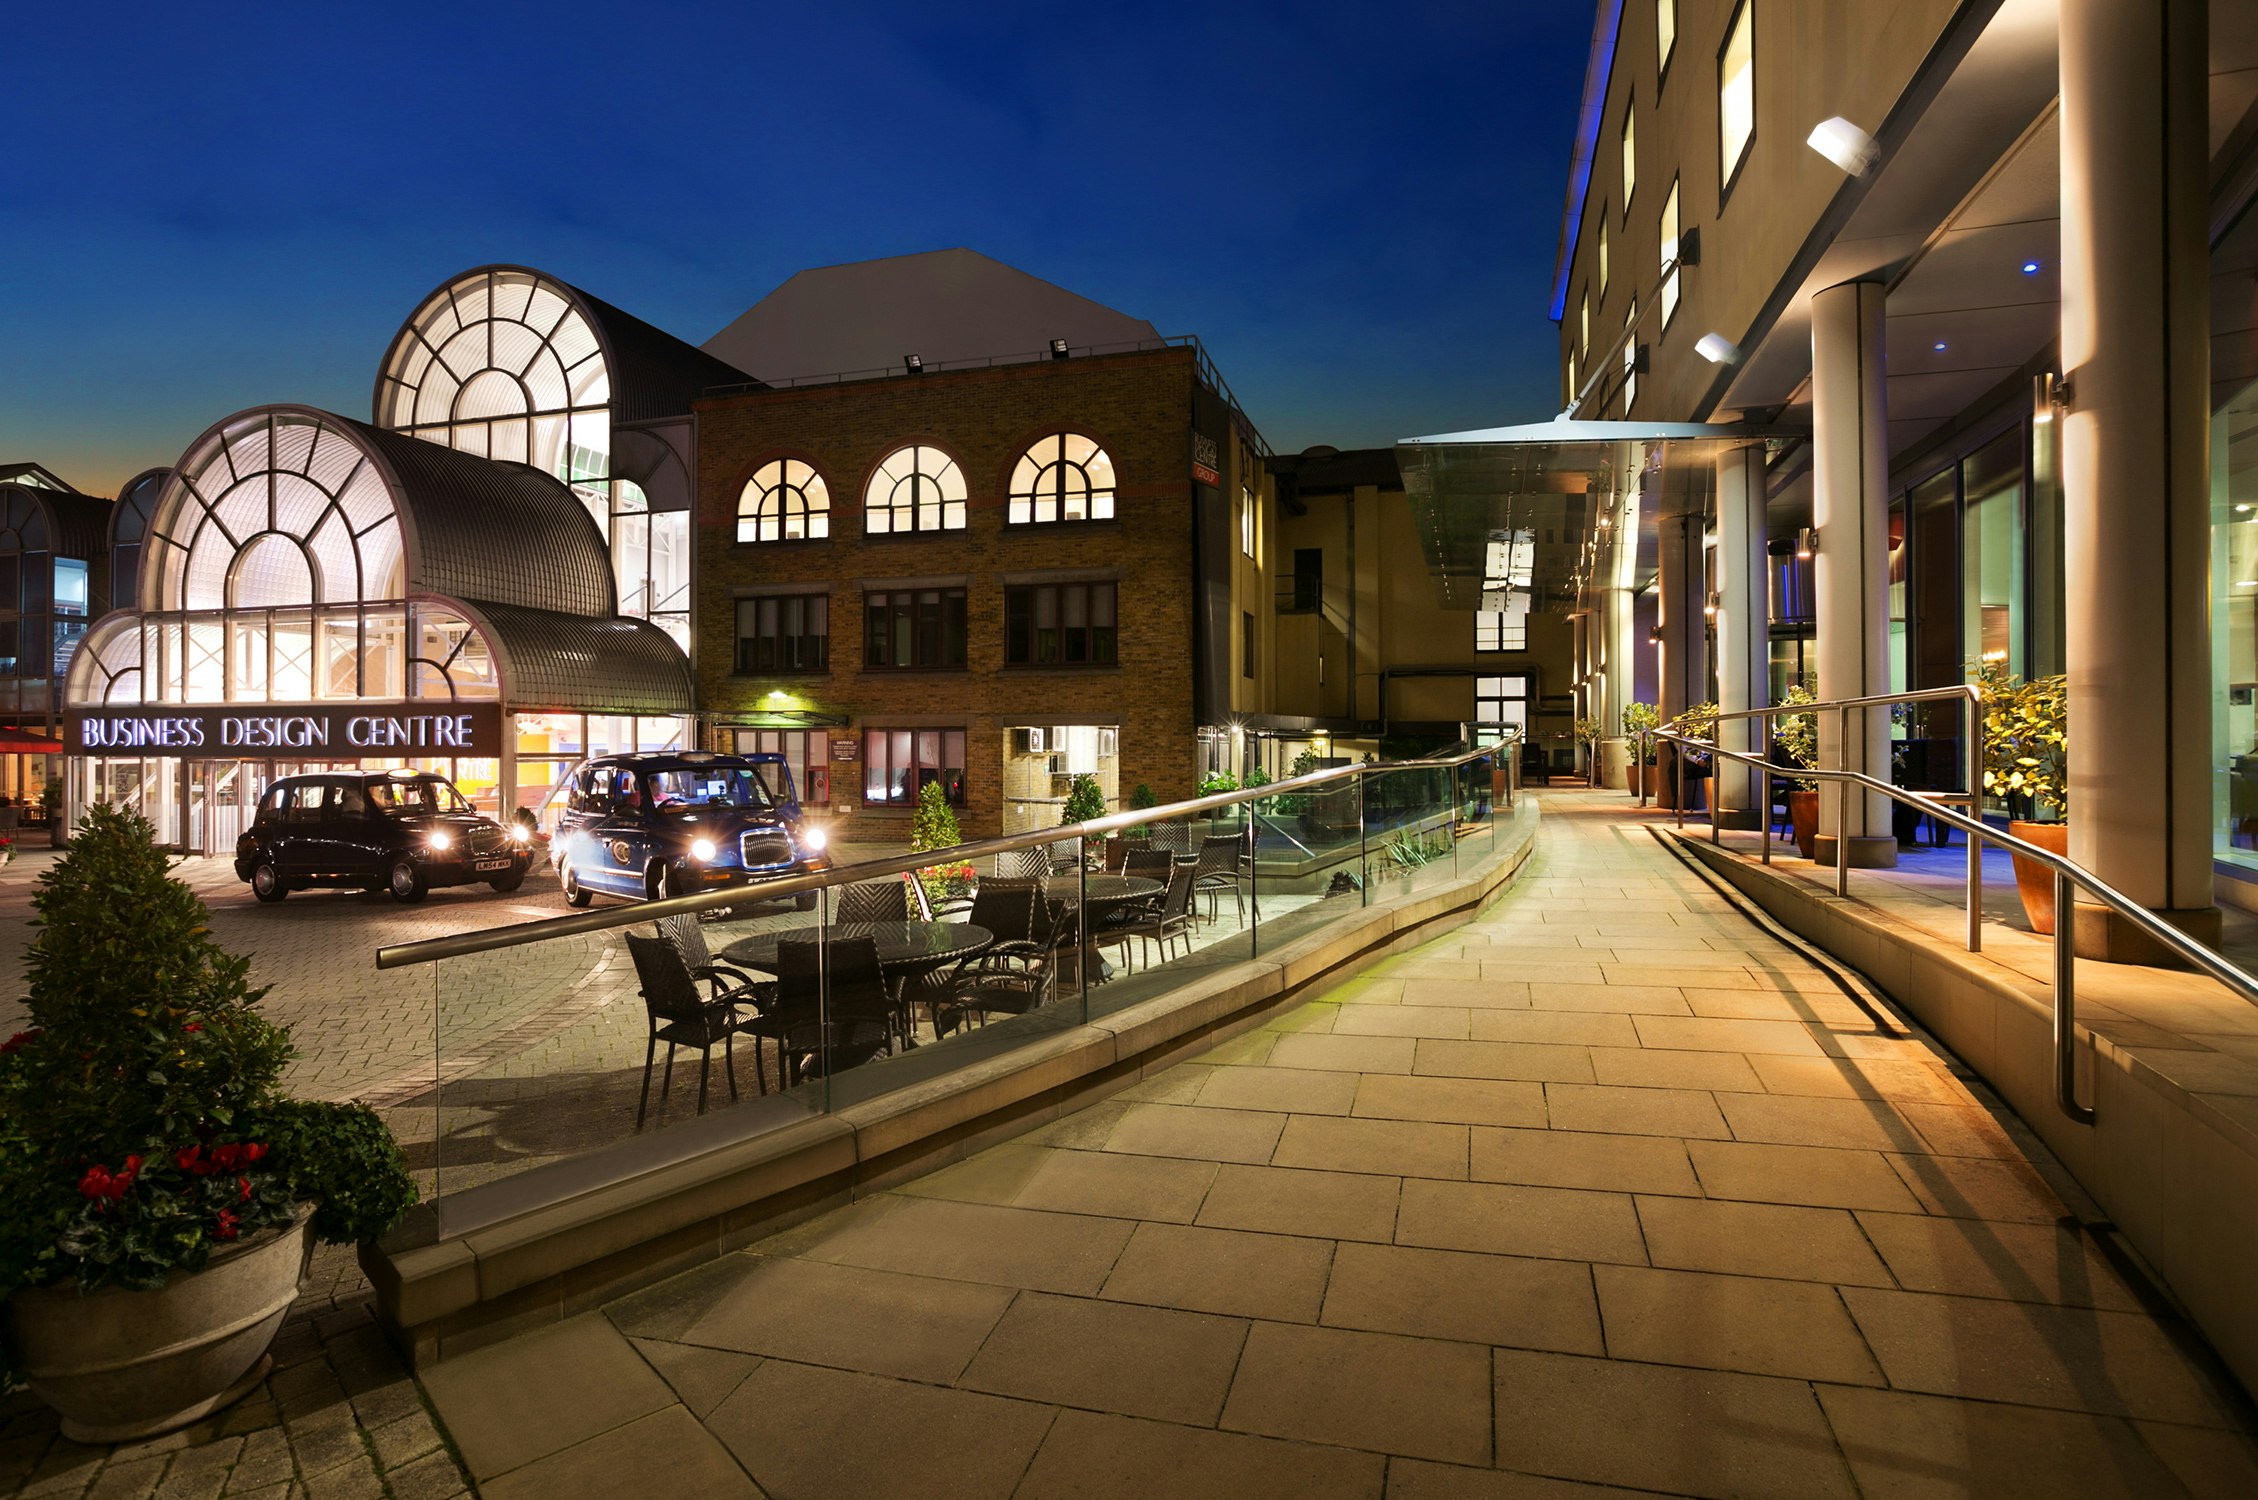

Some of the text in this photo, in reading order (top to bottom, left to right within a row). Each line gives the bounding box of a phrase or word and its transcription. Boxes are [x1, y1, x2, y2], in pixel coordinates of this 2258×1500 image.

[1194, 439, 1217, 458] DESIGN
[1194, 448, 1217, 469] CENTRE
[1197, 467, 1216, 482] GROUP
[83, 714, 473, 747] BUSINESS DESIGN CENTRE
